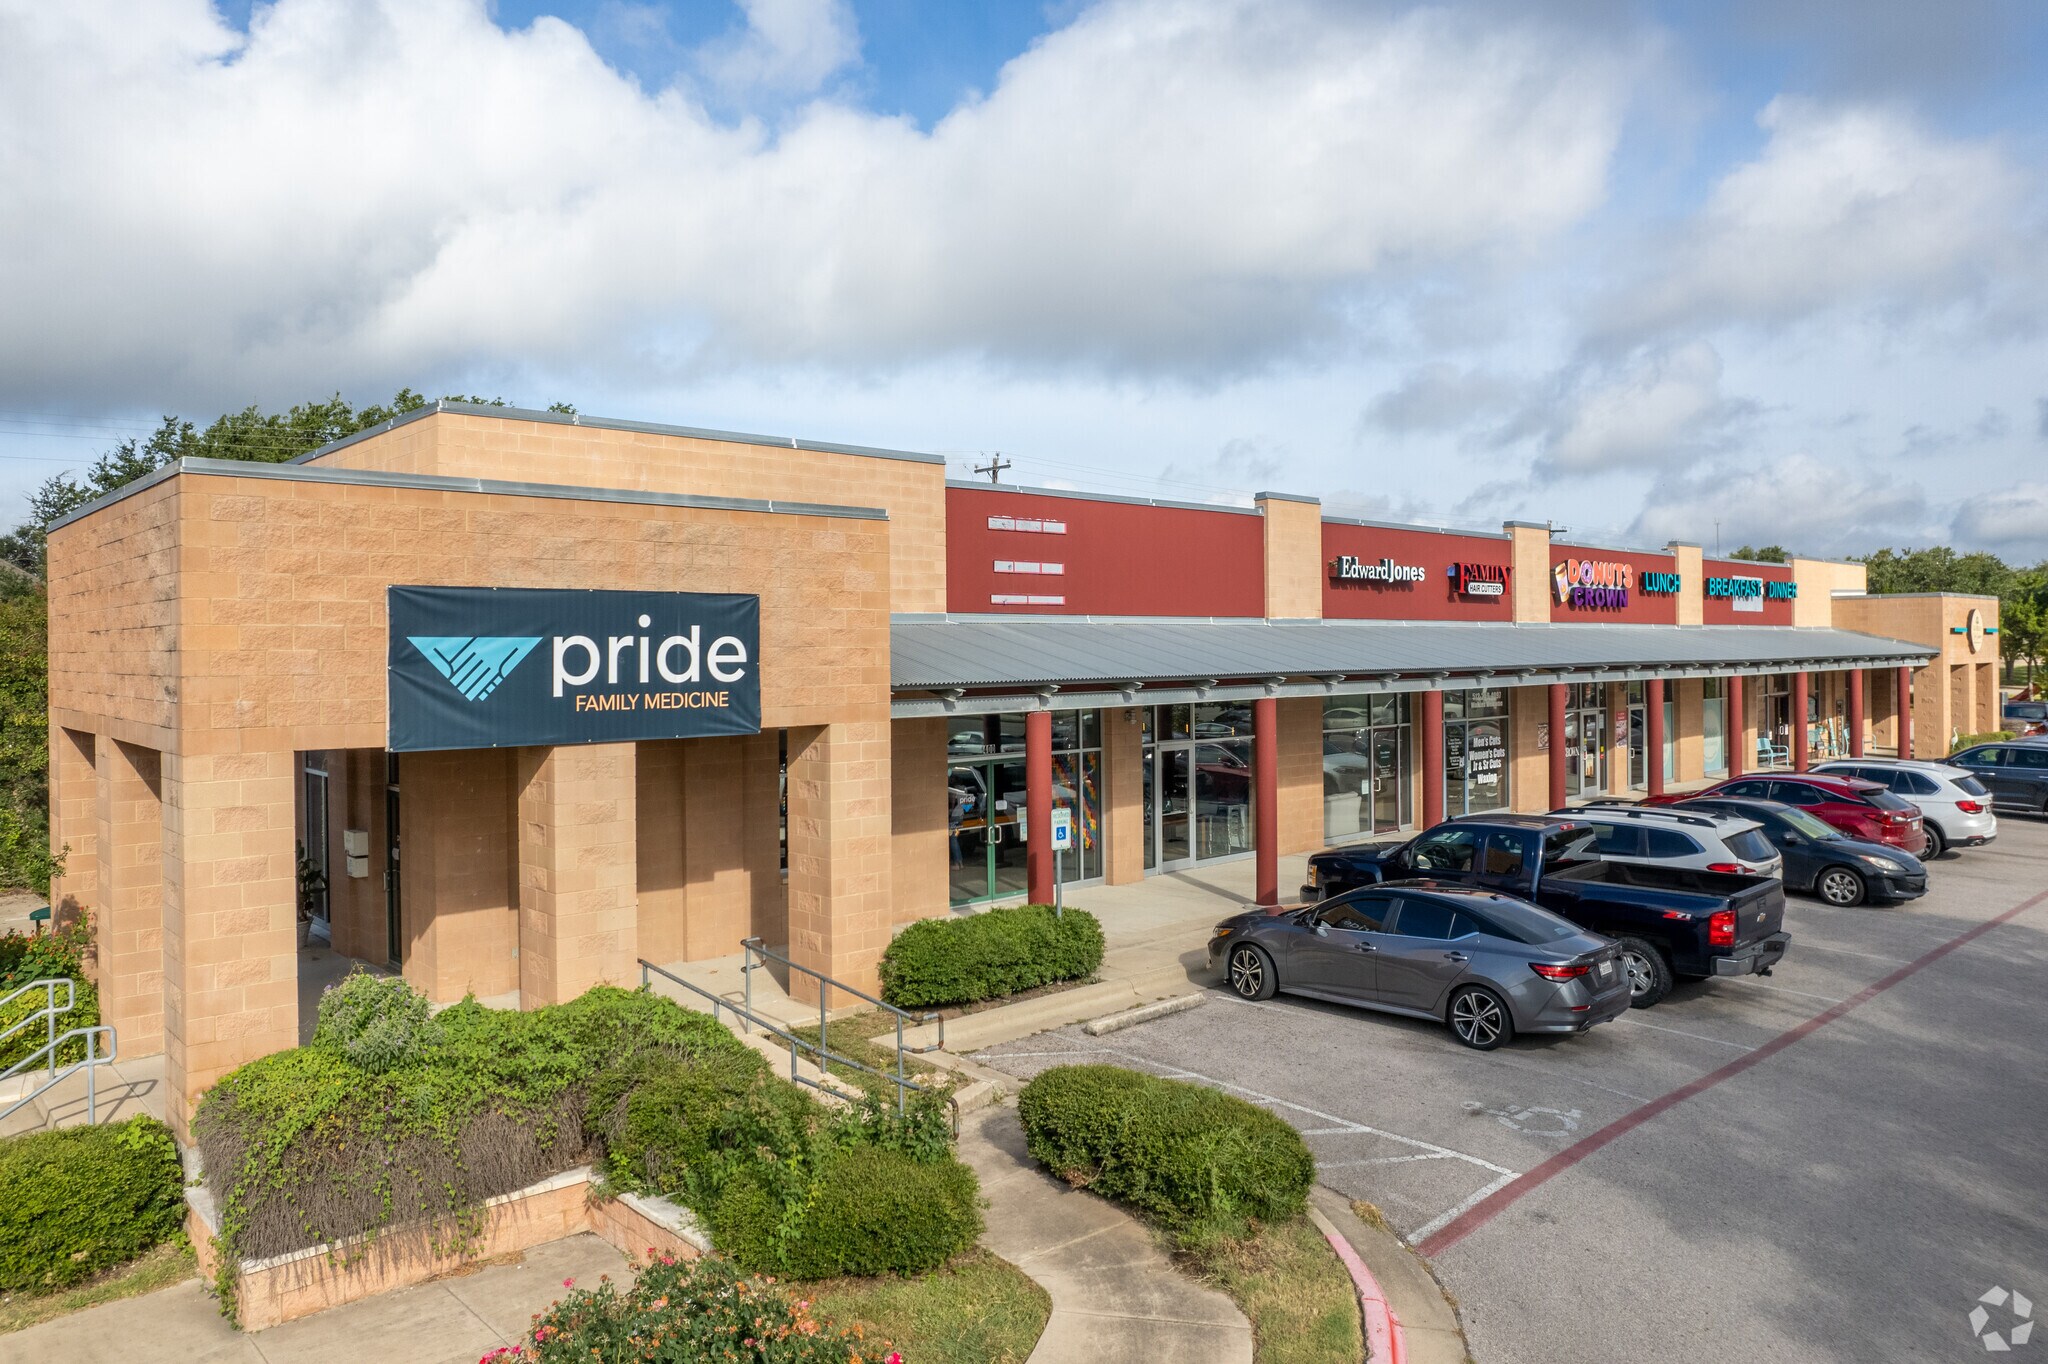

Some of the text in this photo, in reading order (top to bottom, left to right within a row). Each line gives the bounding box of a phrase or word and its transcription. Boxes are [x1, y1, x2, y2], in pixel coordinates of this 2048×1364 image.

[1458, 563, 1513, 594] FAMILY
[1567, 558, 1633, 589] DONUTS
[1645, 571, 1681, 593] LUNCH
[1469, 584, 1502, 594] HAIR CUTTERS
[1709, 577, 1762, 597] BREAKFAST
[1768, 581, 1798, 599] DINNER
[1574, 587, 1628, 608] CROWN
[552, 614, 748, 698] pride
[575, 691, 729, 712] FAMILY MEDICINE
[1473, 737, 1489, 748] Men's
[1489, 736, 1501, 746] Cuts
[1469, 748, 1505, 761] Women's Cuts
[1478, 761, 1482, 770] &
[1489, 759, 1501, 769] Cuts
[1477, 773, 1498, 784] Waxing
